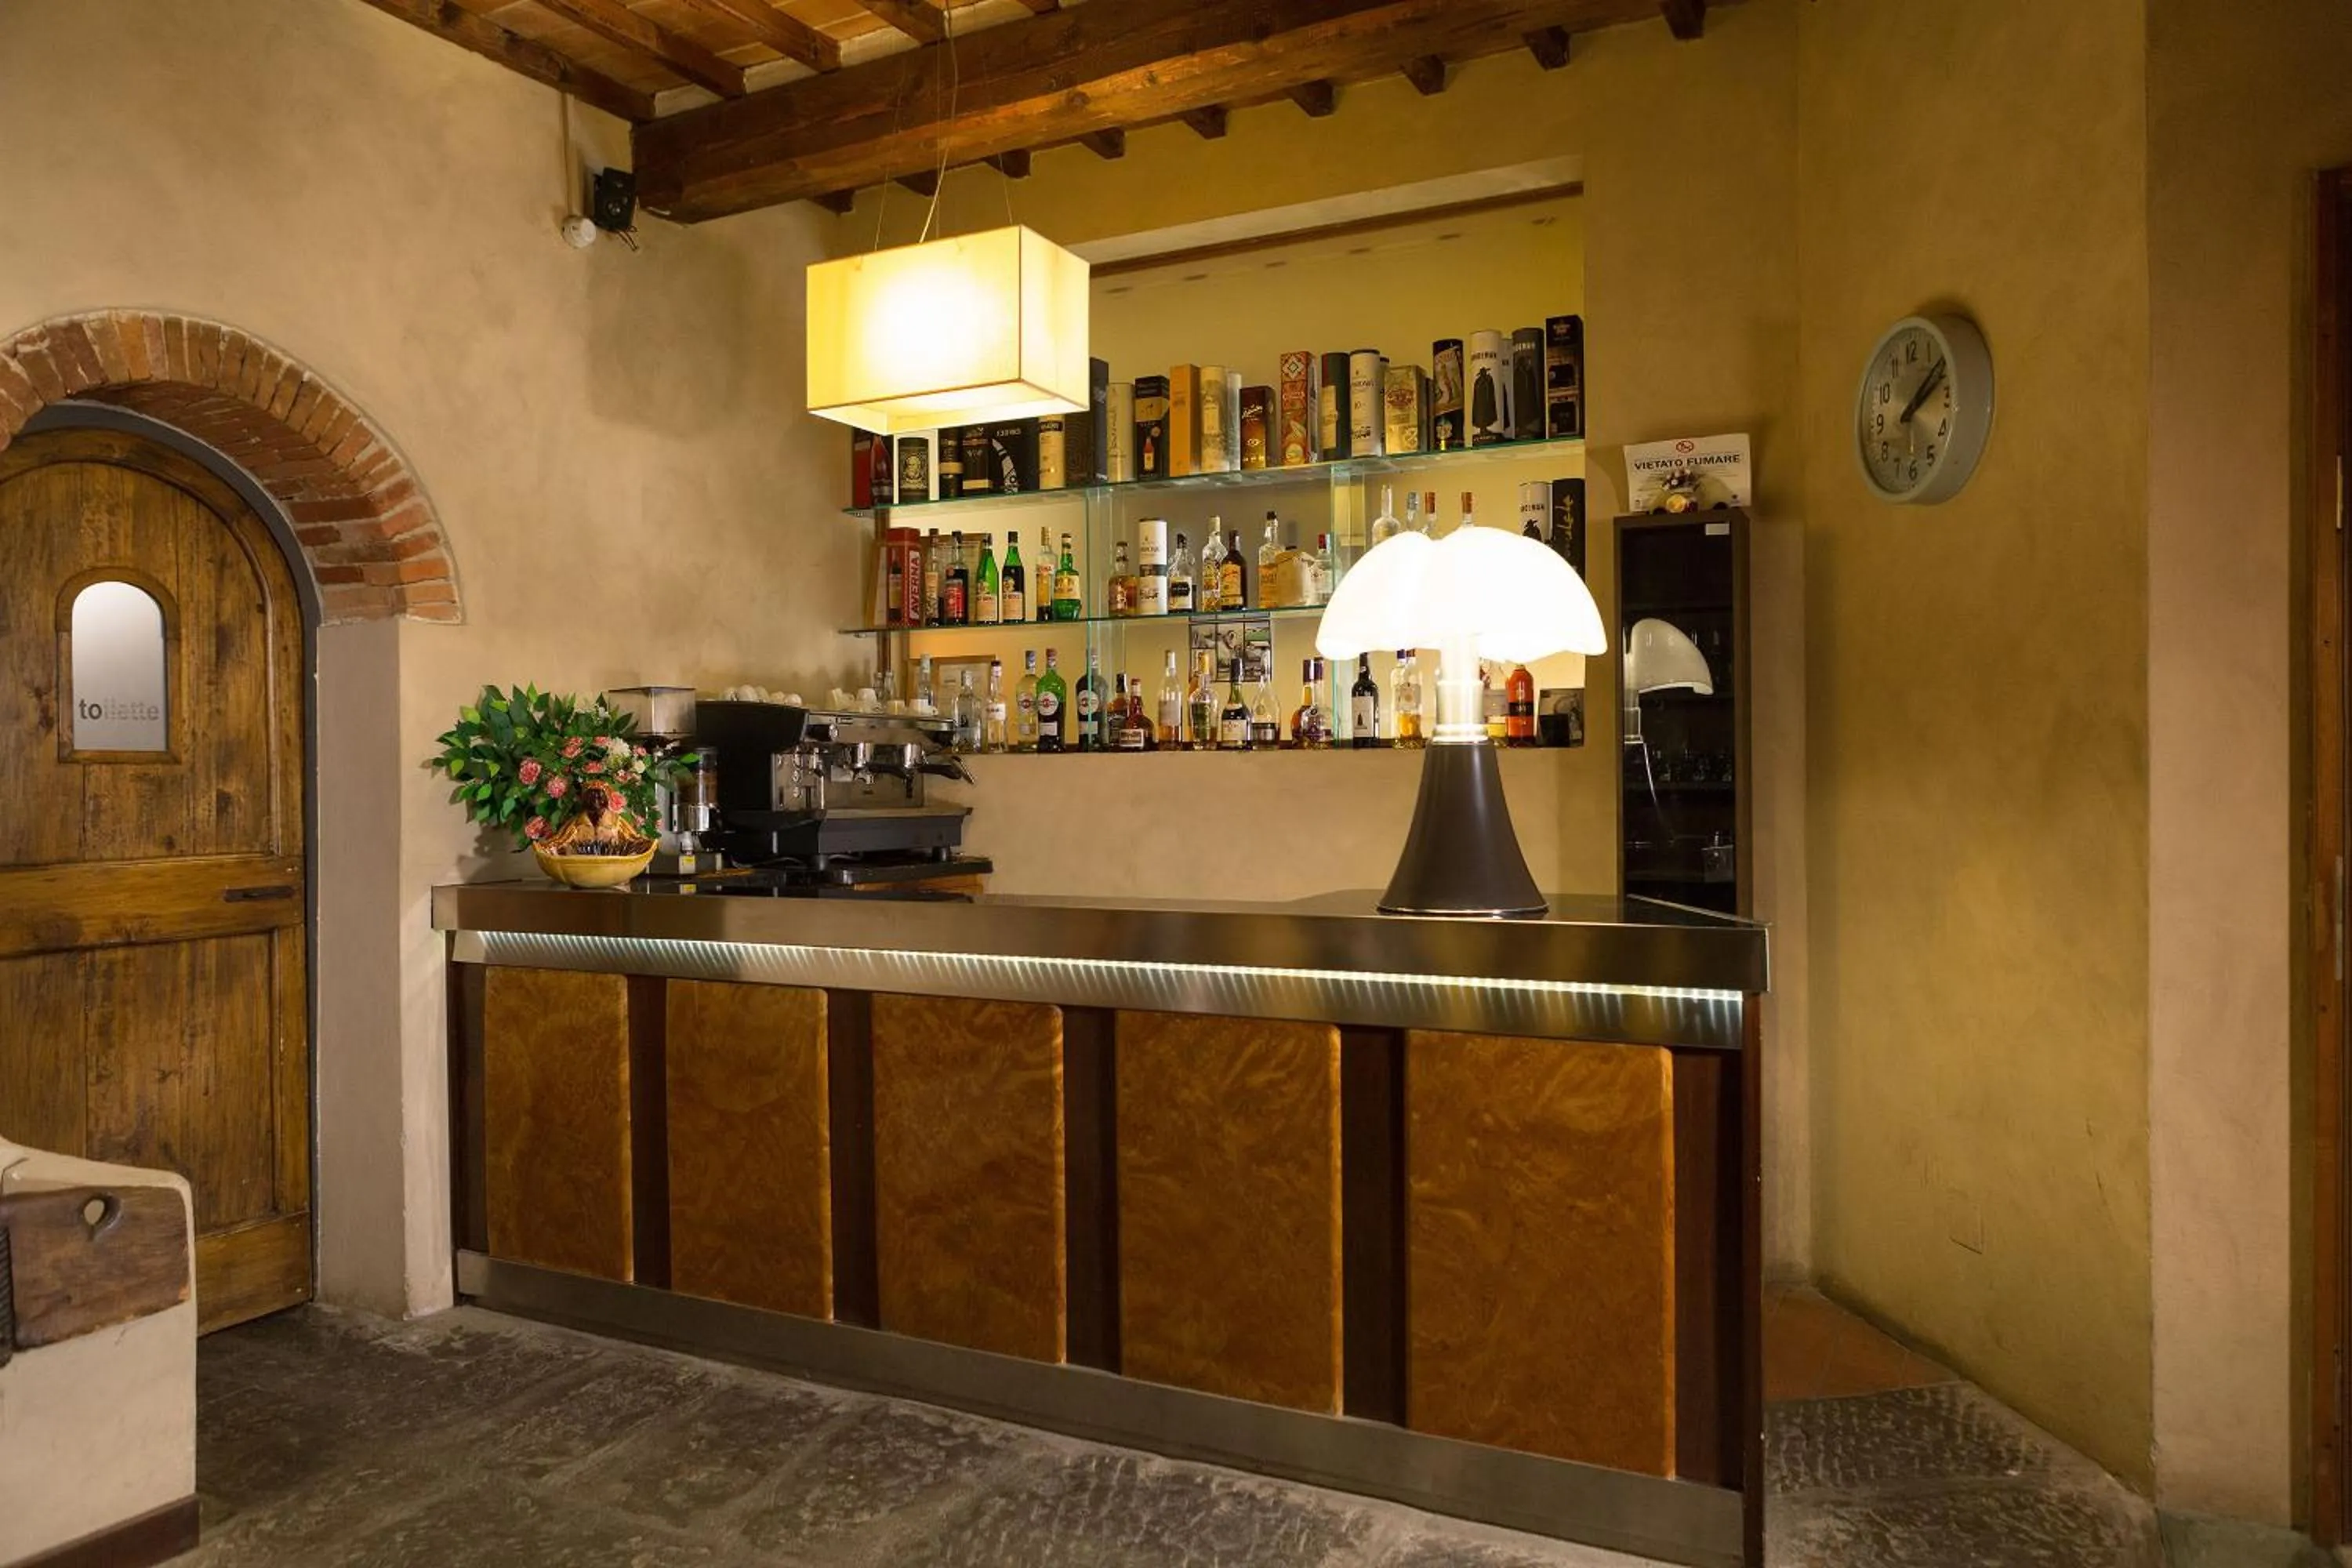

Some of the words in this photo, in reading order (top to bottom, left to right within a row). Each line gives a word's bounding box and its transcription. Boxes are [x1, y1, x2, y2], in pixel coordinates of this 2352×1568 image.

[1906, 340, 1918, 364] 12
[1926, 343, 1931, 362] 1
[1892, 358, 1899, 379] 11
[1880, 383, 1890, 406] 10
[1876, 414, 1884, 435] 9
[1938, 418, 1947, 437] 4
[1634, 459, 1683, 470] VIETATO
[1687, 454, 1740, 466] FUMARE
[1882, 441, 1889, 463] 8
[1926, 445, 1936, 466] 5
[1893, 458, 1902, 478] 7
[1908, 459, 1918, 481] 6
[910, 557, 920, 614] AVERNA
